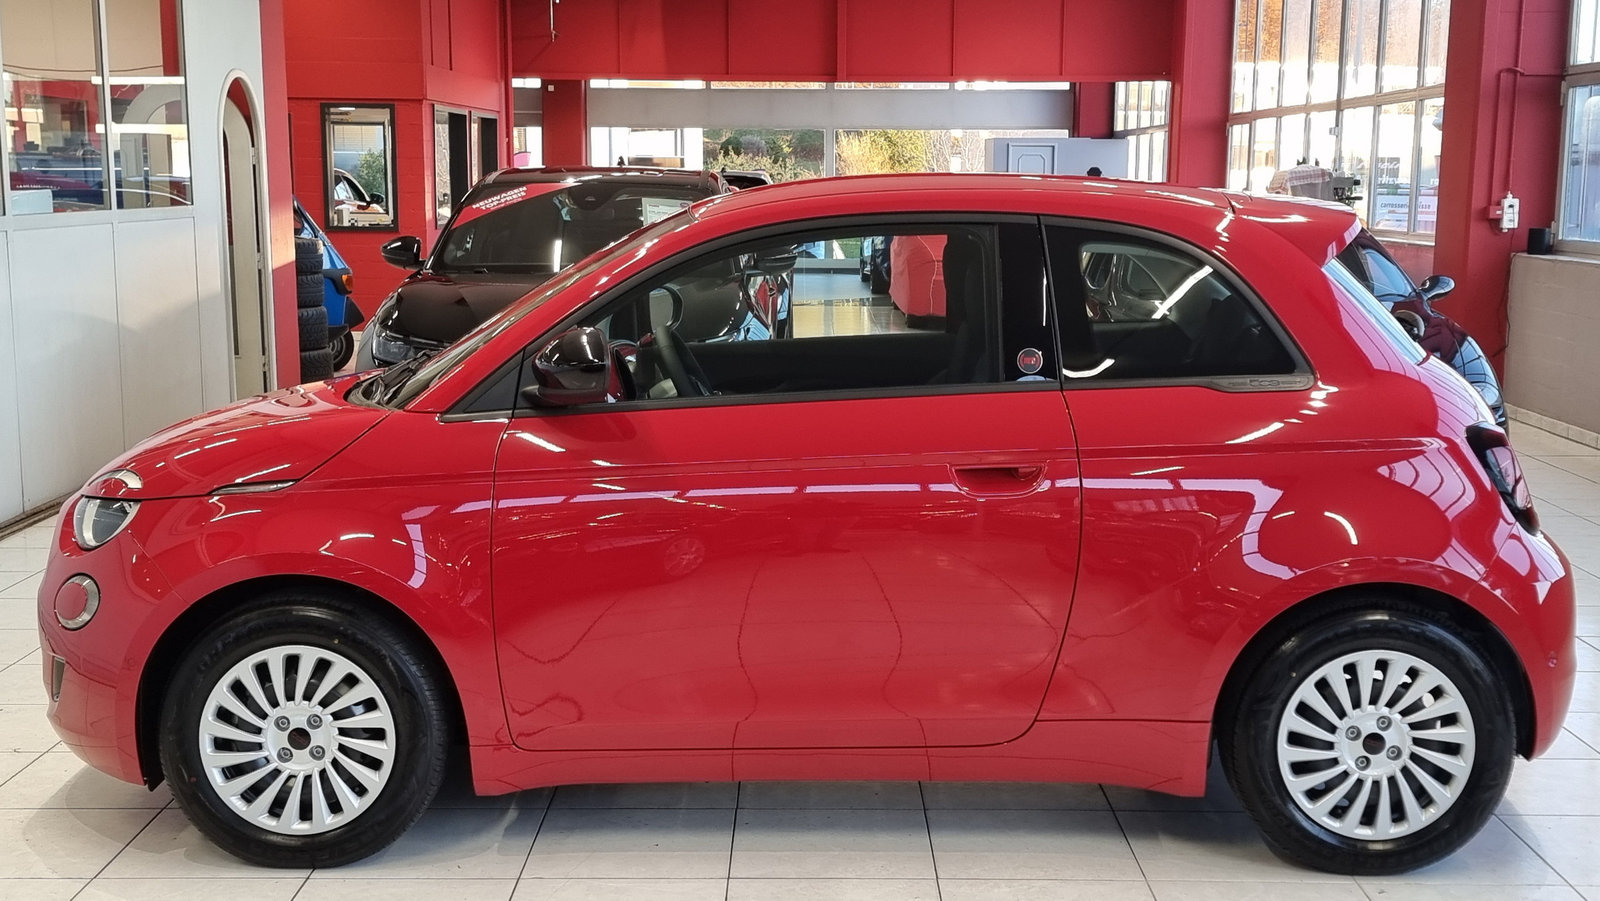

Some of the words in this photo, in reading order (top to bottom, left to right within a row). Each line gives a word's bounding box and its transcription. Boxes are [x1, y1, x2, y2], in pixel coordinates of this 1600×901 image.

[472, 186, 527, 209] NEUWAGEN
[480, 191, 526, 210] TOP-PREIS
[1380, 201, 1409, 209] carrosseri
